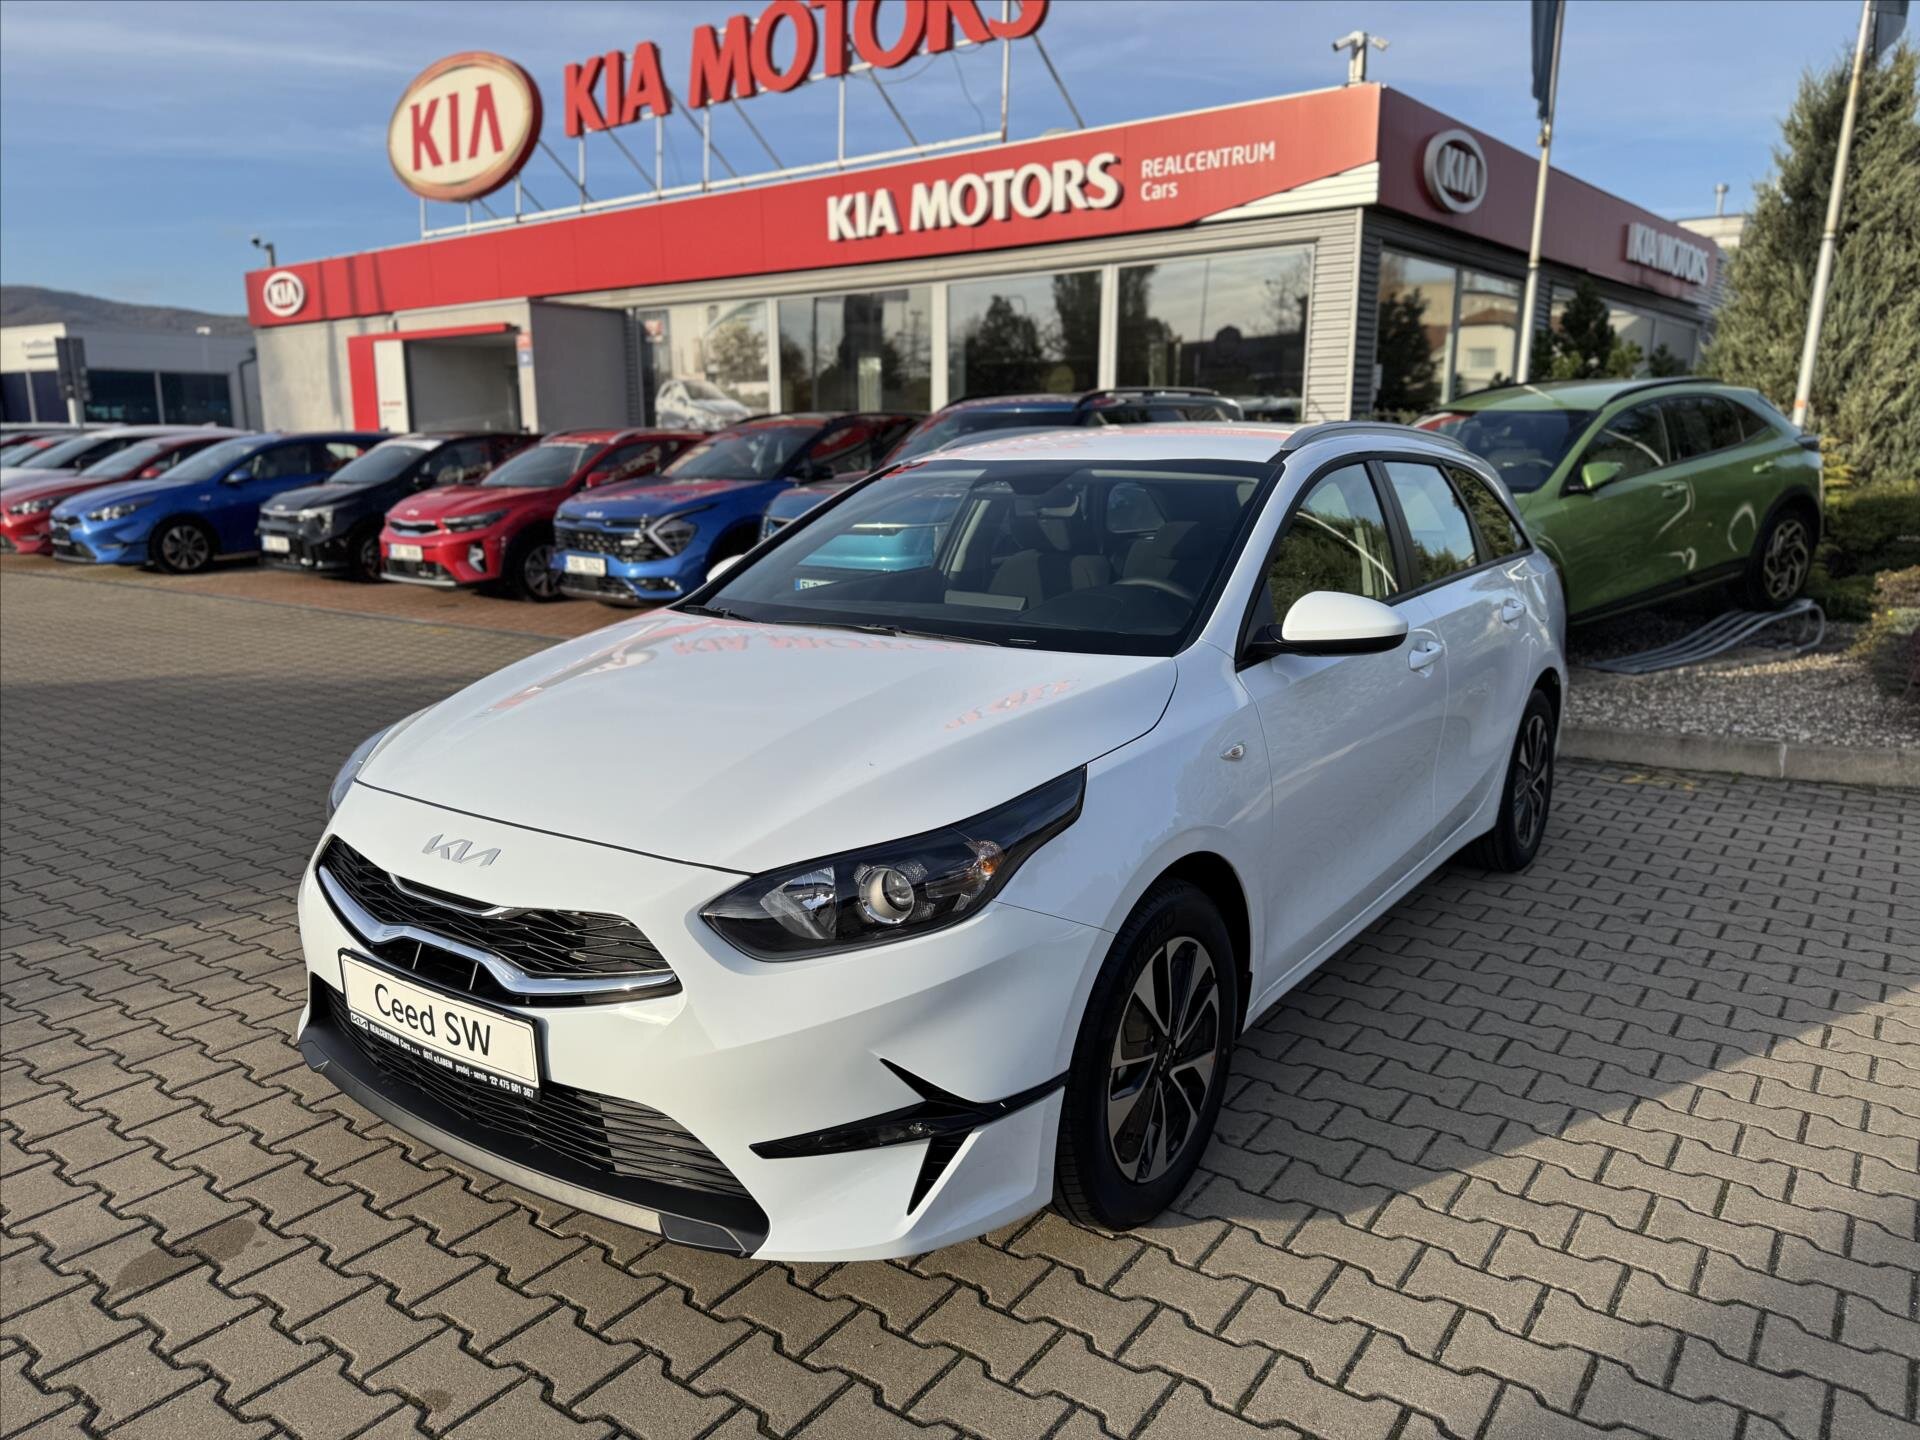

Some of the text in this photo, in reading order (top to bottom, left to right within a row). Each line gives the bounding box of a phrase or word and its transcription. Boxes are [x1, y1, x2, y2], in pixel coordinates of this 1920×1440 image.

[564, 41, 672, 138] KIA
[410, 83, 504, 171] KIA
[1141, 141, 1275, 178] REALCENTRUM
[1443, 144, 1478, 198] KIA
[827, 152, 1121, 242] KIA MOTORS
[1140, 182, 1178, 201] Cars
[1625, 222, 1658, 268] KIA
[422, 833, 502, 867] KIA
[374, 983, 491, 1056] Ceed SW
[369, 1023, 400, 1046] REALCENTRUM
[400, 1039, 411, 1051] Cars
[499, 1078, 510, 1090] 475
[510, 1082, 522, 1094] 601
[523, 1086, 534, 1098] 367
